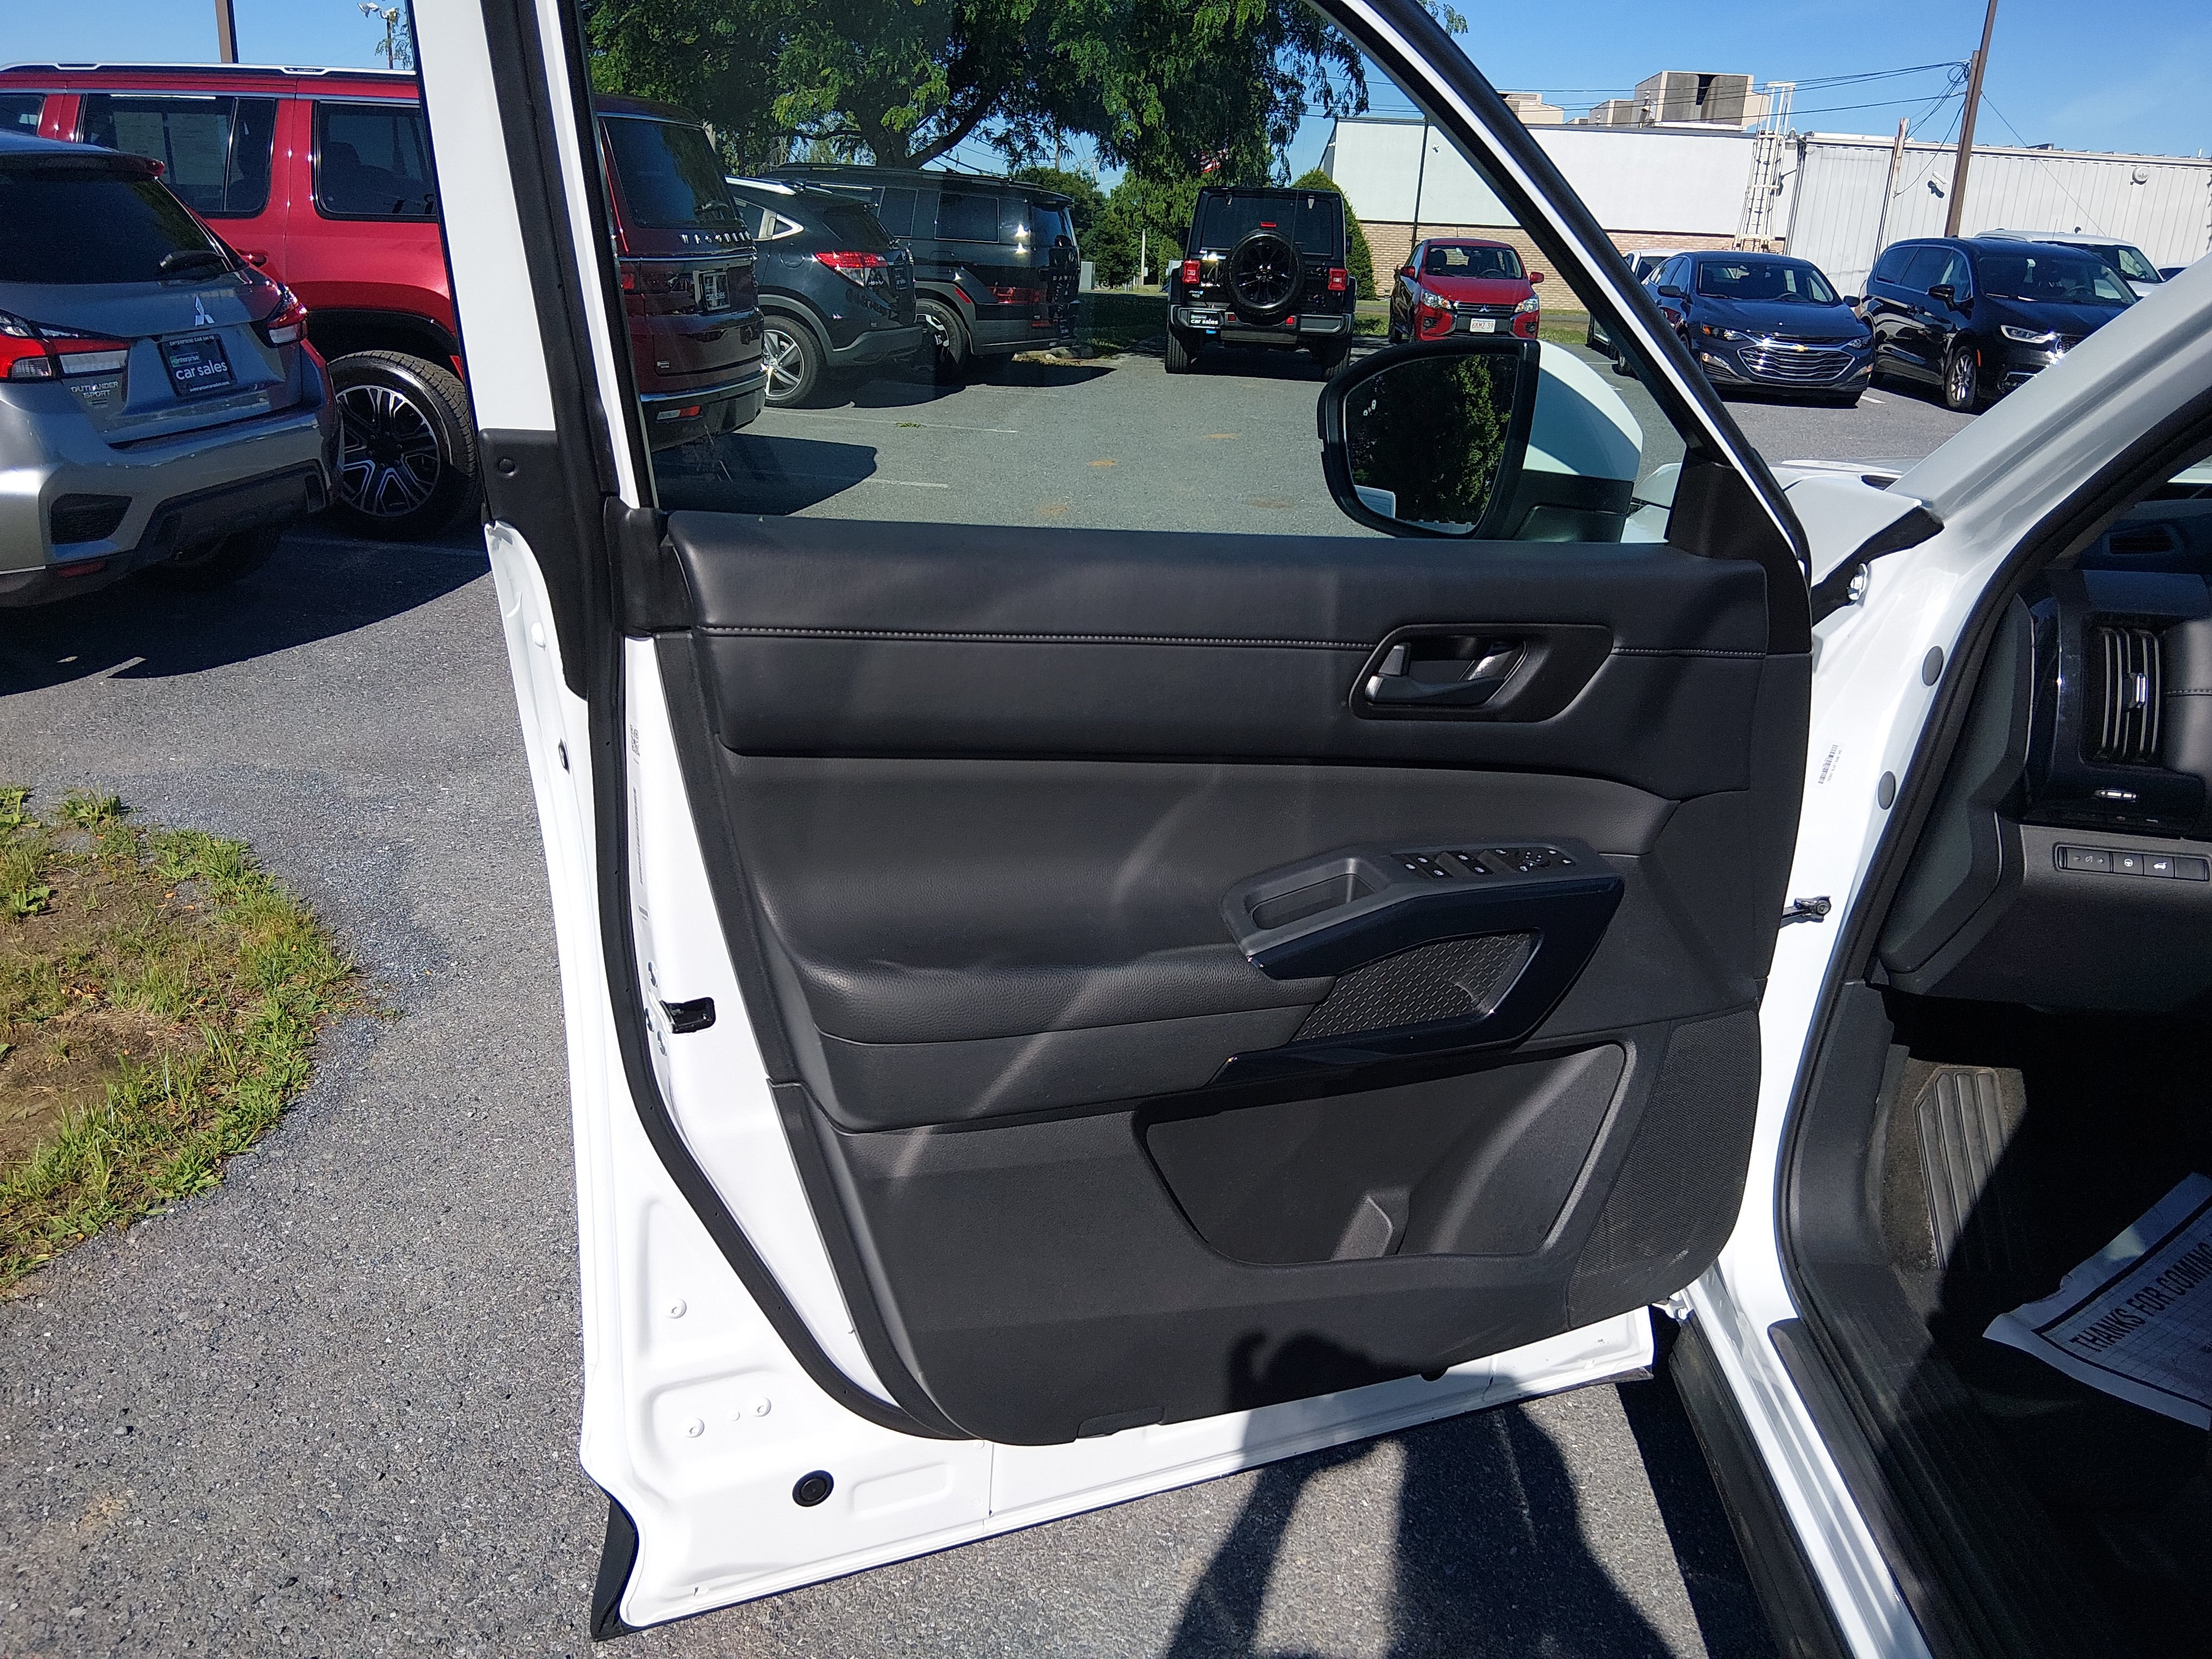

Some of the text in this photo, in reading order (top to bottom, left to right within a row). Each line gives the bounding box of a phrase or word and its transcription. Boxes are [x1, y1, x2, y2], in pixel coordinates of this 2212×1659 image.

[176, 359, 228, 380] car sales
[70, 381, 118, 393] OUTLANDER
[83, 390, 111, 398] SPORT
[2069, 1242, 2212, 1353] THANKS FOR COMING
